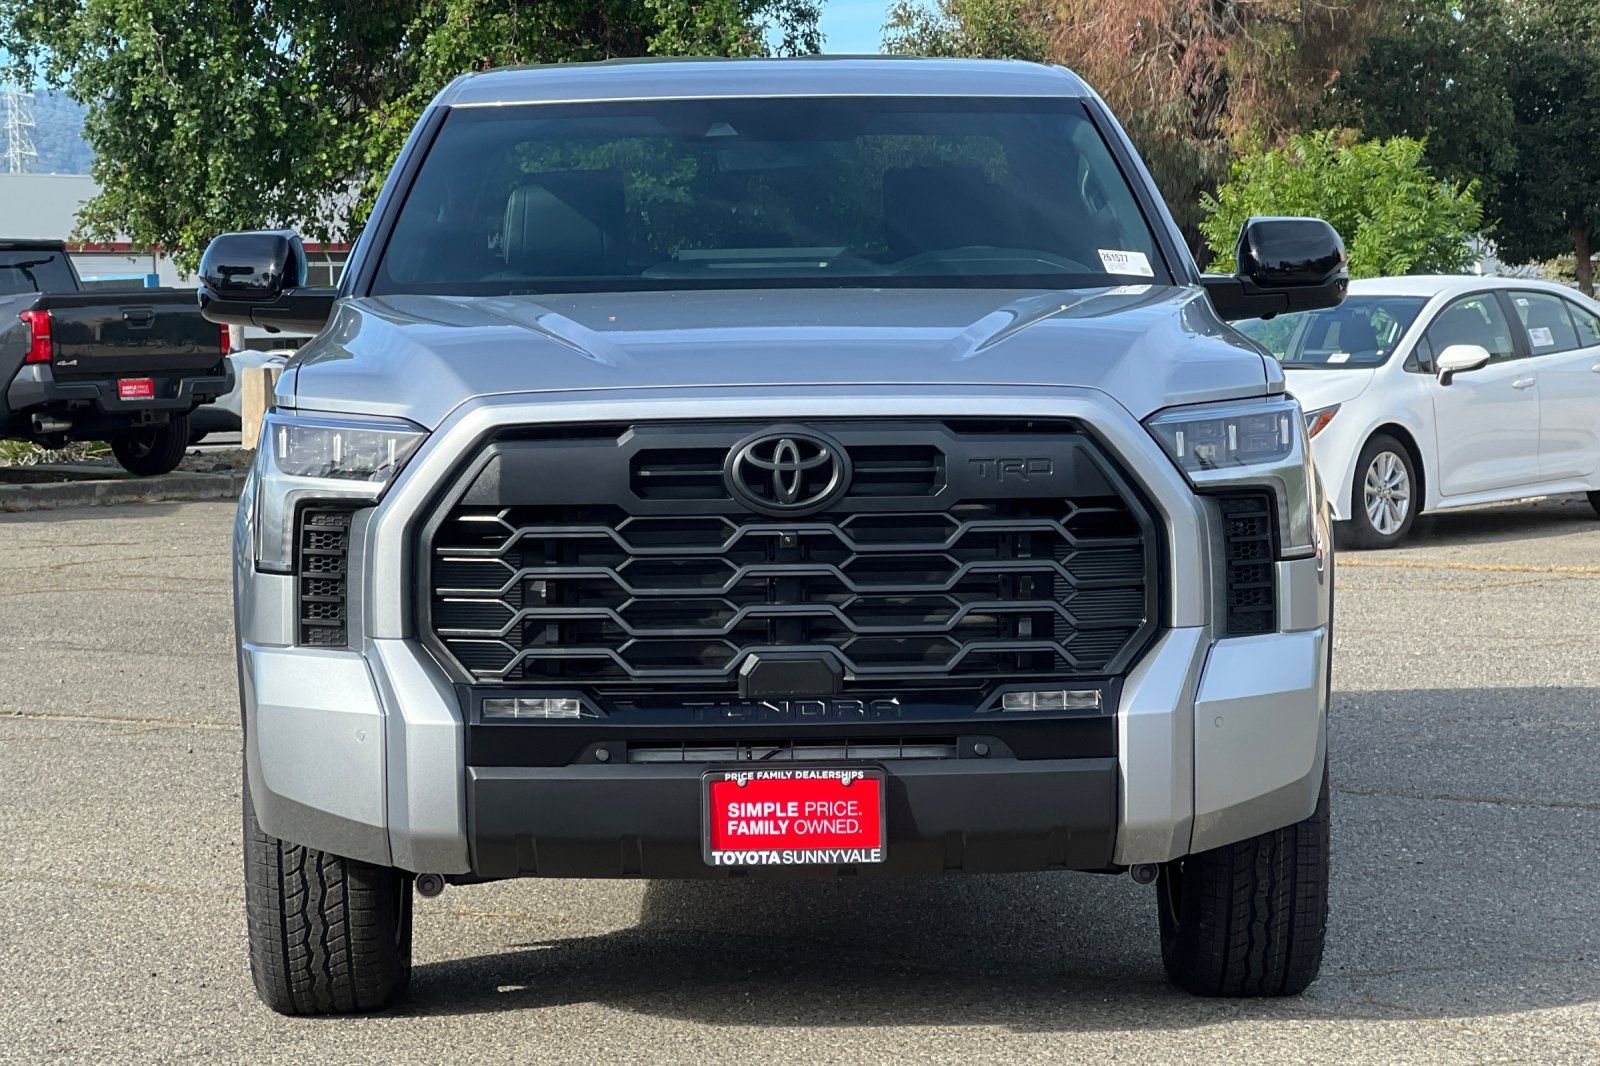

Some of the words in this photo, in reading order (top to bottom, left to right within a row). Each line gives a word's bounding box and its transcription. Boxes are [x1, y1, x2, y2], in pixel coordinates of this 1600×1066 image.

[967, 458, 1054, 481] TRD
[682, 698, 901, 720] TUNDRA
[725, 772, 754, 781] PRICE
[757, 771, 793, 780] FAMILY
[795, 770, 864, 780] DEALERSHIPS
[727, 801, 799, 818] SIMPLE
[804, 800, 863, 817] PRICE.
[727, 819, 790, 836] FAMILY
[793, 818, 863, 835] OWNED.
